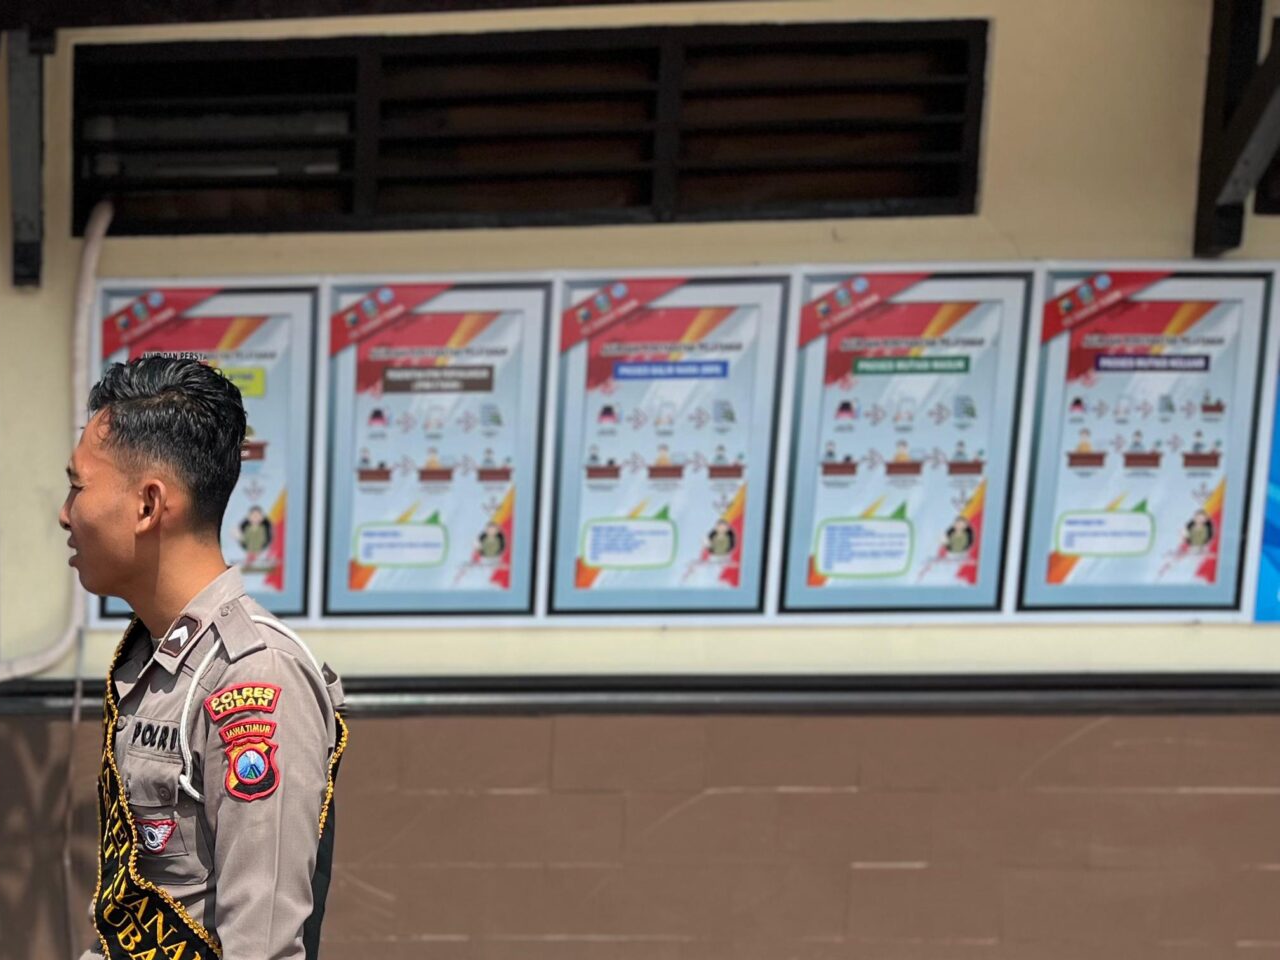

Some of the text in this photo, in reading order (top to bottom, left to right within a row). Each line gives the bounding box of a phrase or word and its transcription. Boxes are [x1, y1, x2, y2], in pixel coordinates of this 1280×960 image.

[211, 687, 275, 711] POLRES
[215, 697, 269, 713] TUBAN
[131, 721, 178, 751] POLRI
